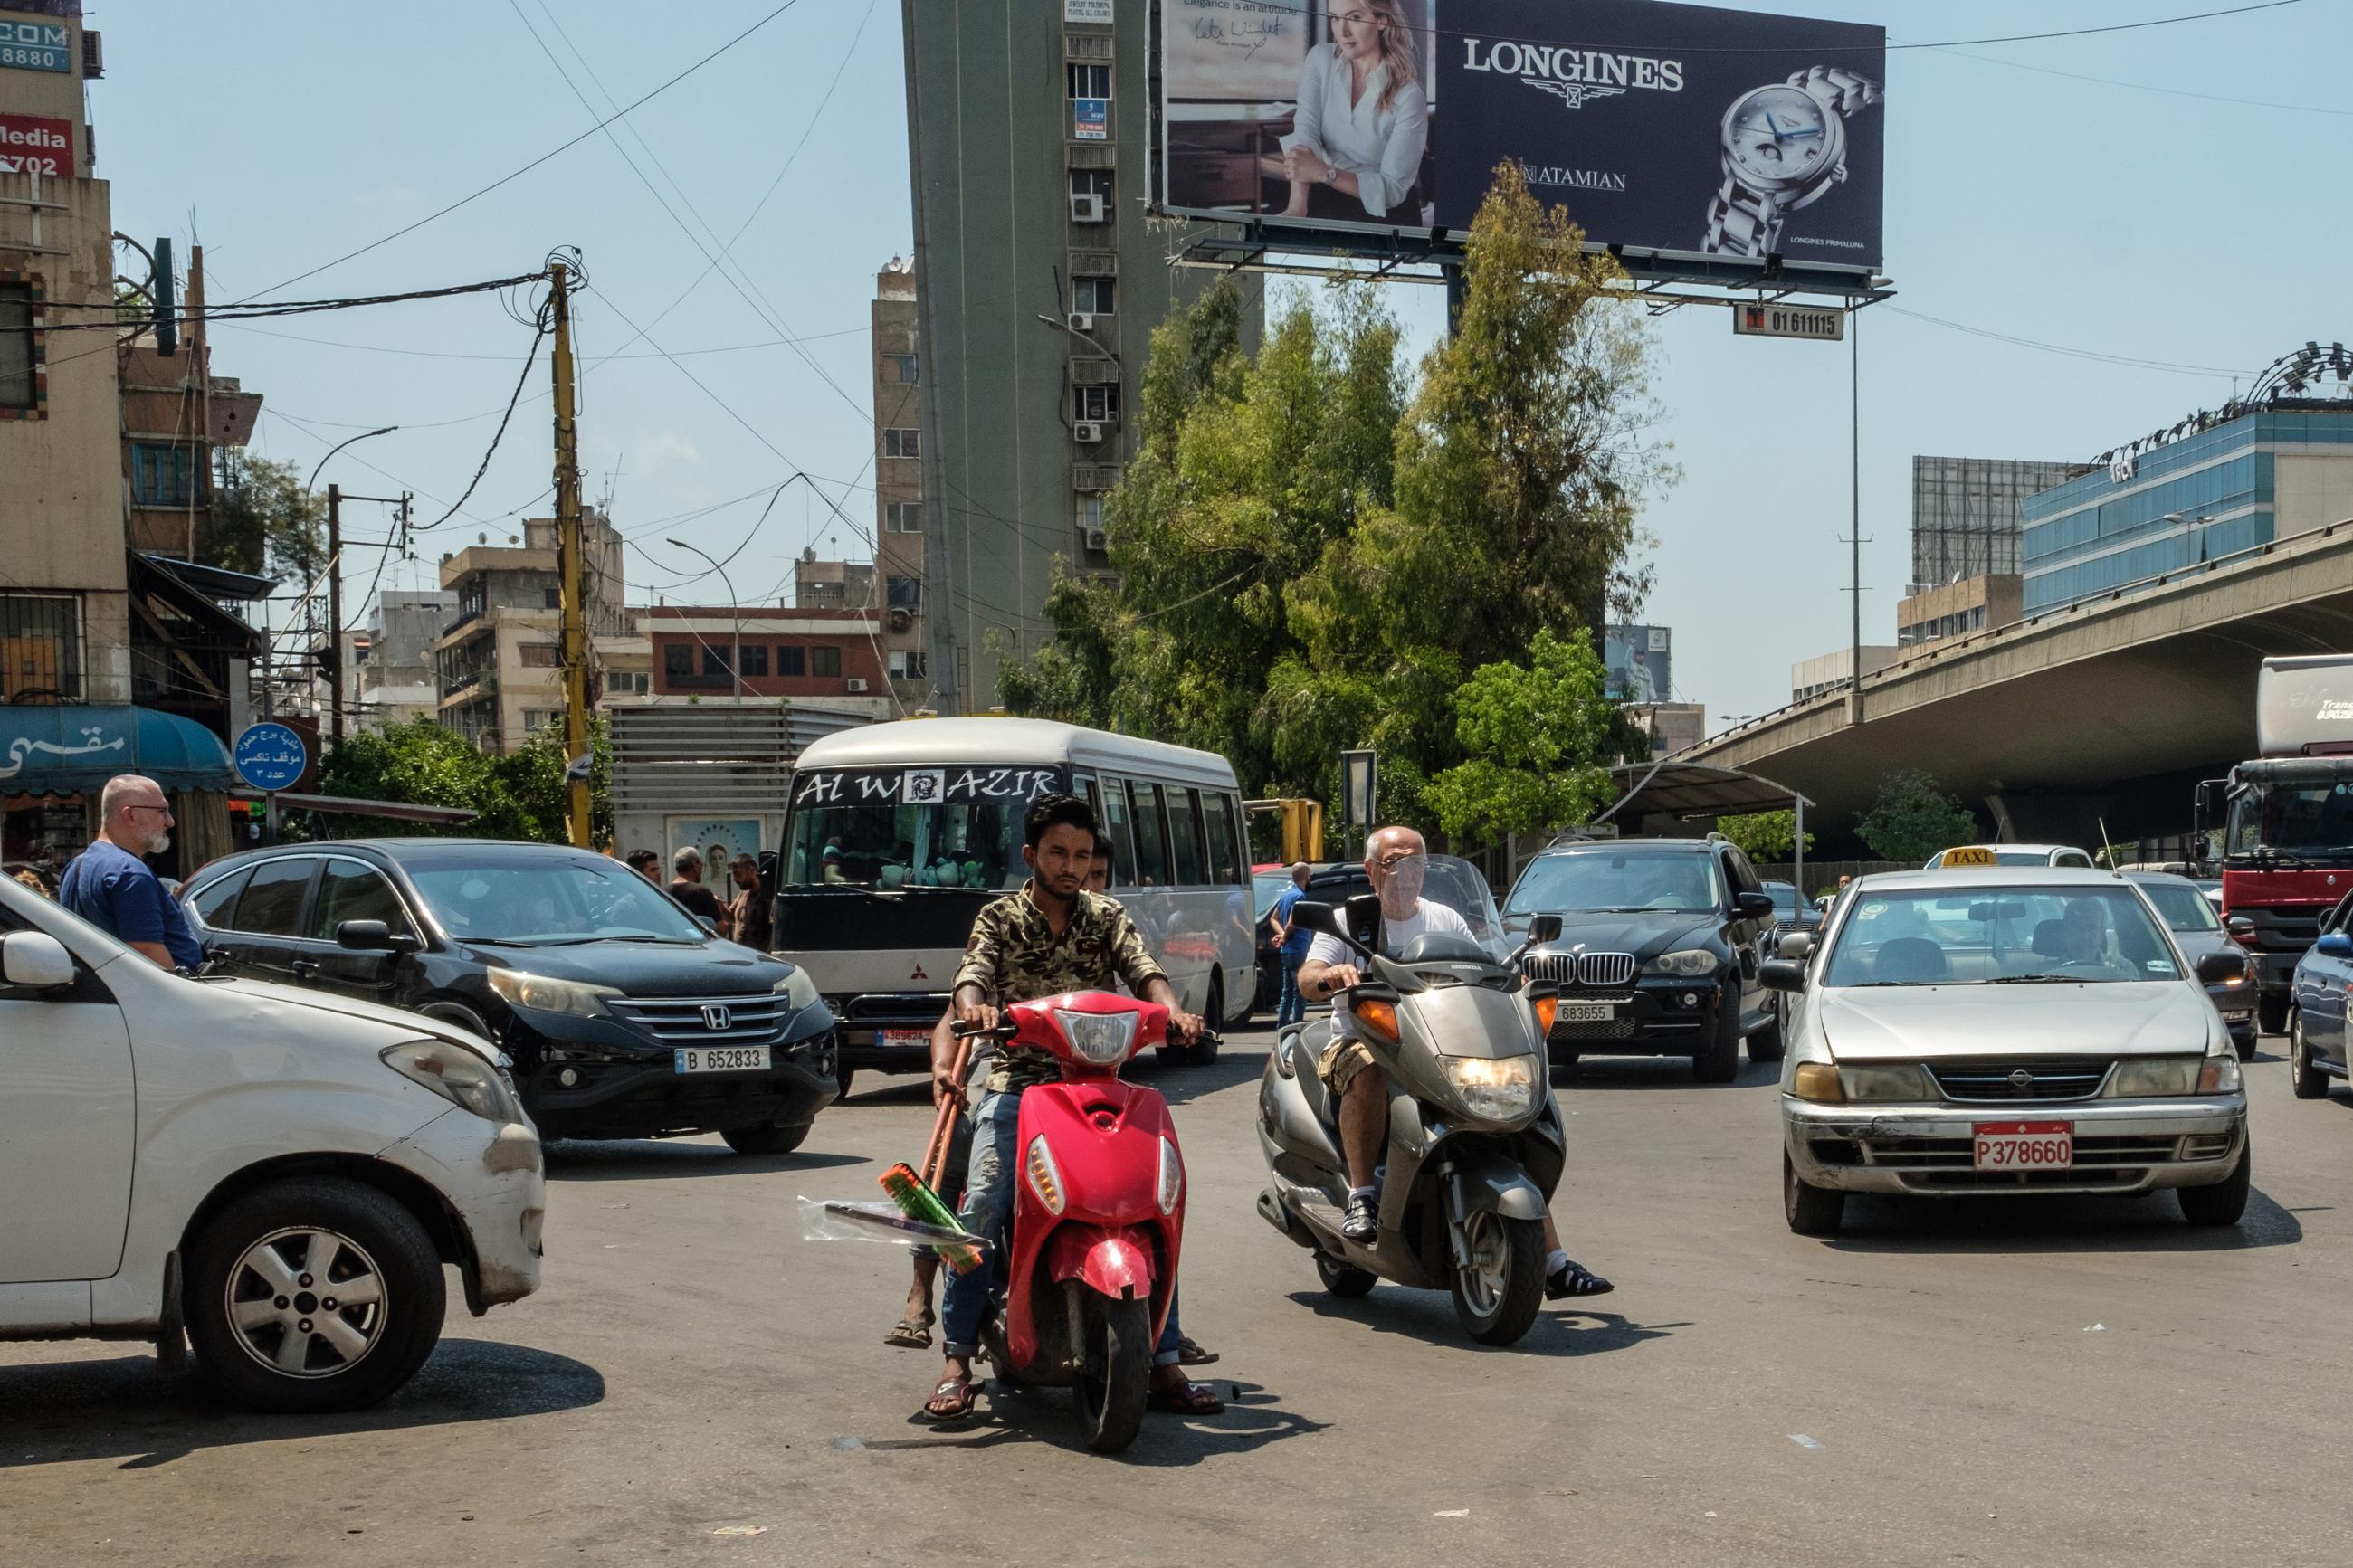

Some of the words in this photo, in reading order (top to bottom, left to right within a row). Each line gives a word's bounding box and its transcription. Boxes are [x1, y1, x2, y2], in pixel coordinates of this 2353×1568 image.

[1233, 2, 1241, 11] is
[1258, 4, 1298, 16] attitude
[3, 48, 55, 67] 8880
[1463, 38, 1684, 92] LONGINES
[1538, 166, 1626, 189] ATAMIAN
[1790, 236, 1824, 245] LONGINES
[1825, 239, 1864, 249] PRIMALUNA
[1773, 311, 1787, 331] 01
[1791, 312, 1835, 335] 611115
[238, 736, 258, 751] حمود
[260, 730, 277, 741] برج
[280, 731, 299, 750] بلدية
[240, 752, 270, 766] تاكسي
[272, 751, 300, 765] موقف
[947, 769, 1058, 803] AZIR
[1951, 851, 1988, 863] TAXI
[1562, 1006, 1606, 1020] 683655
[689, 1052, 698, 1069] B
[707, 1050, 760, 1069] 652833
[1977, 1140, 2070, 1165] P378660
